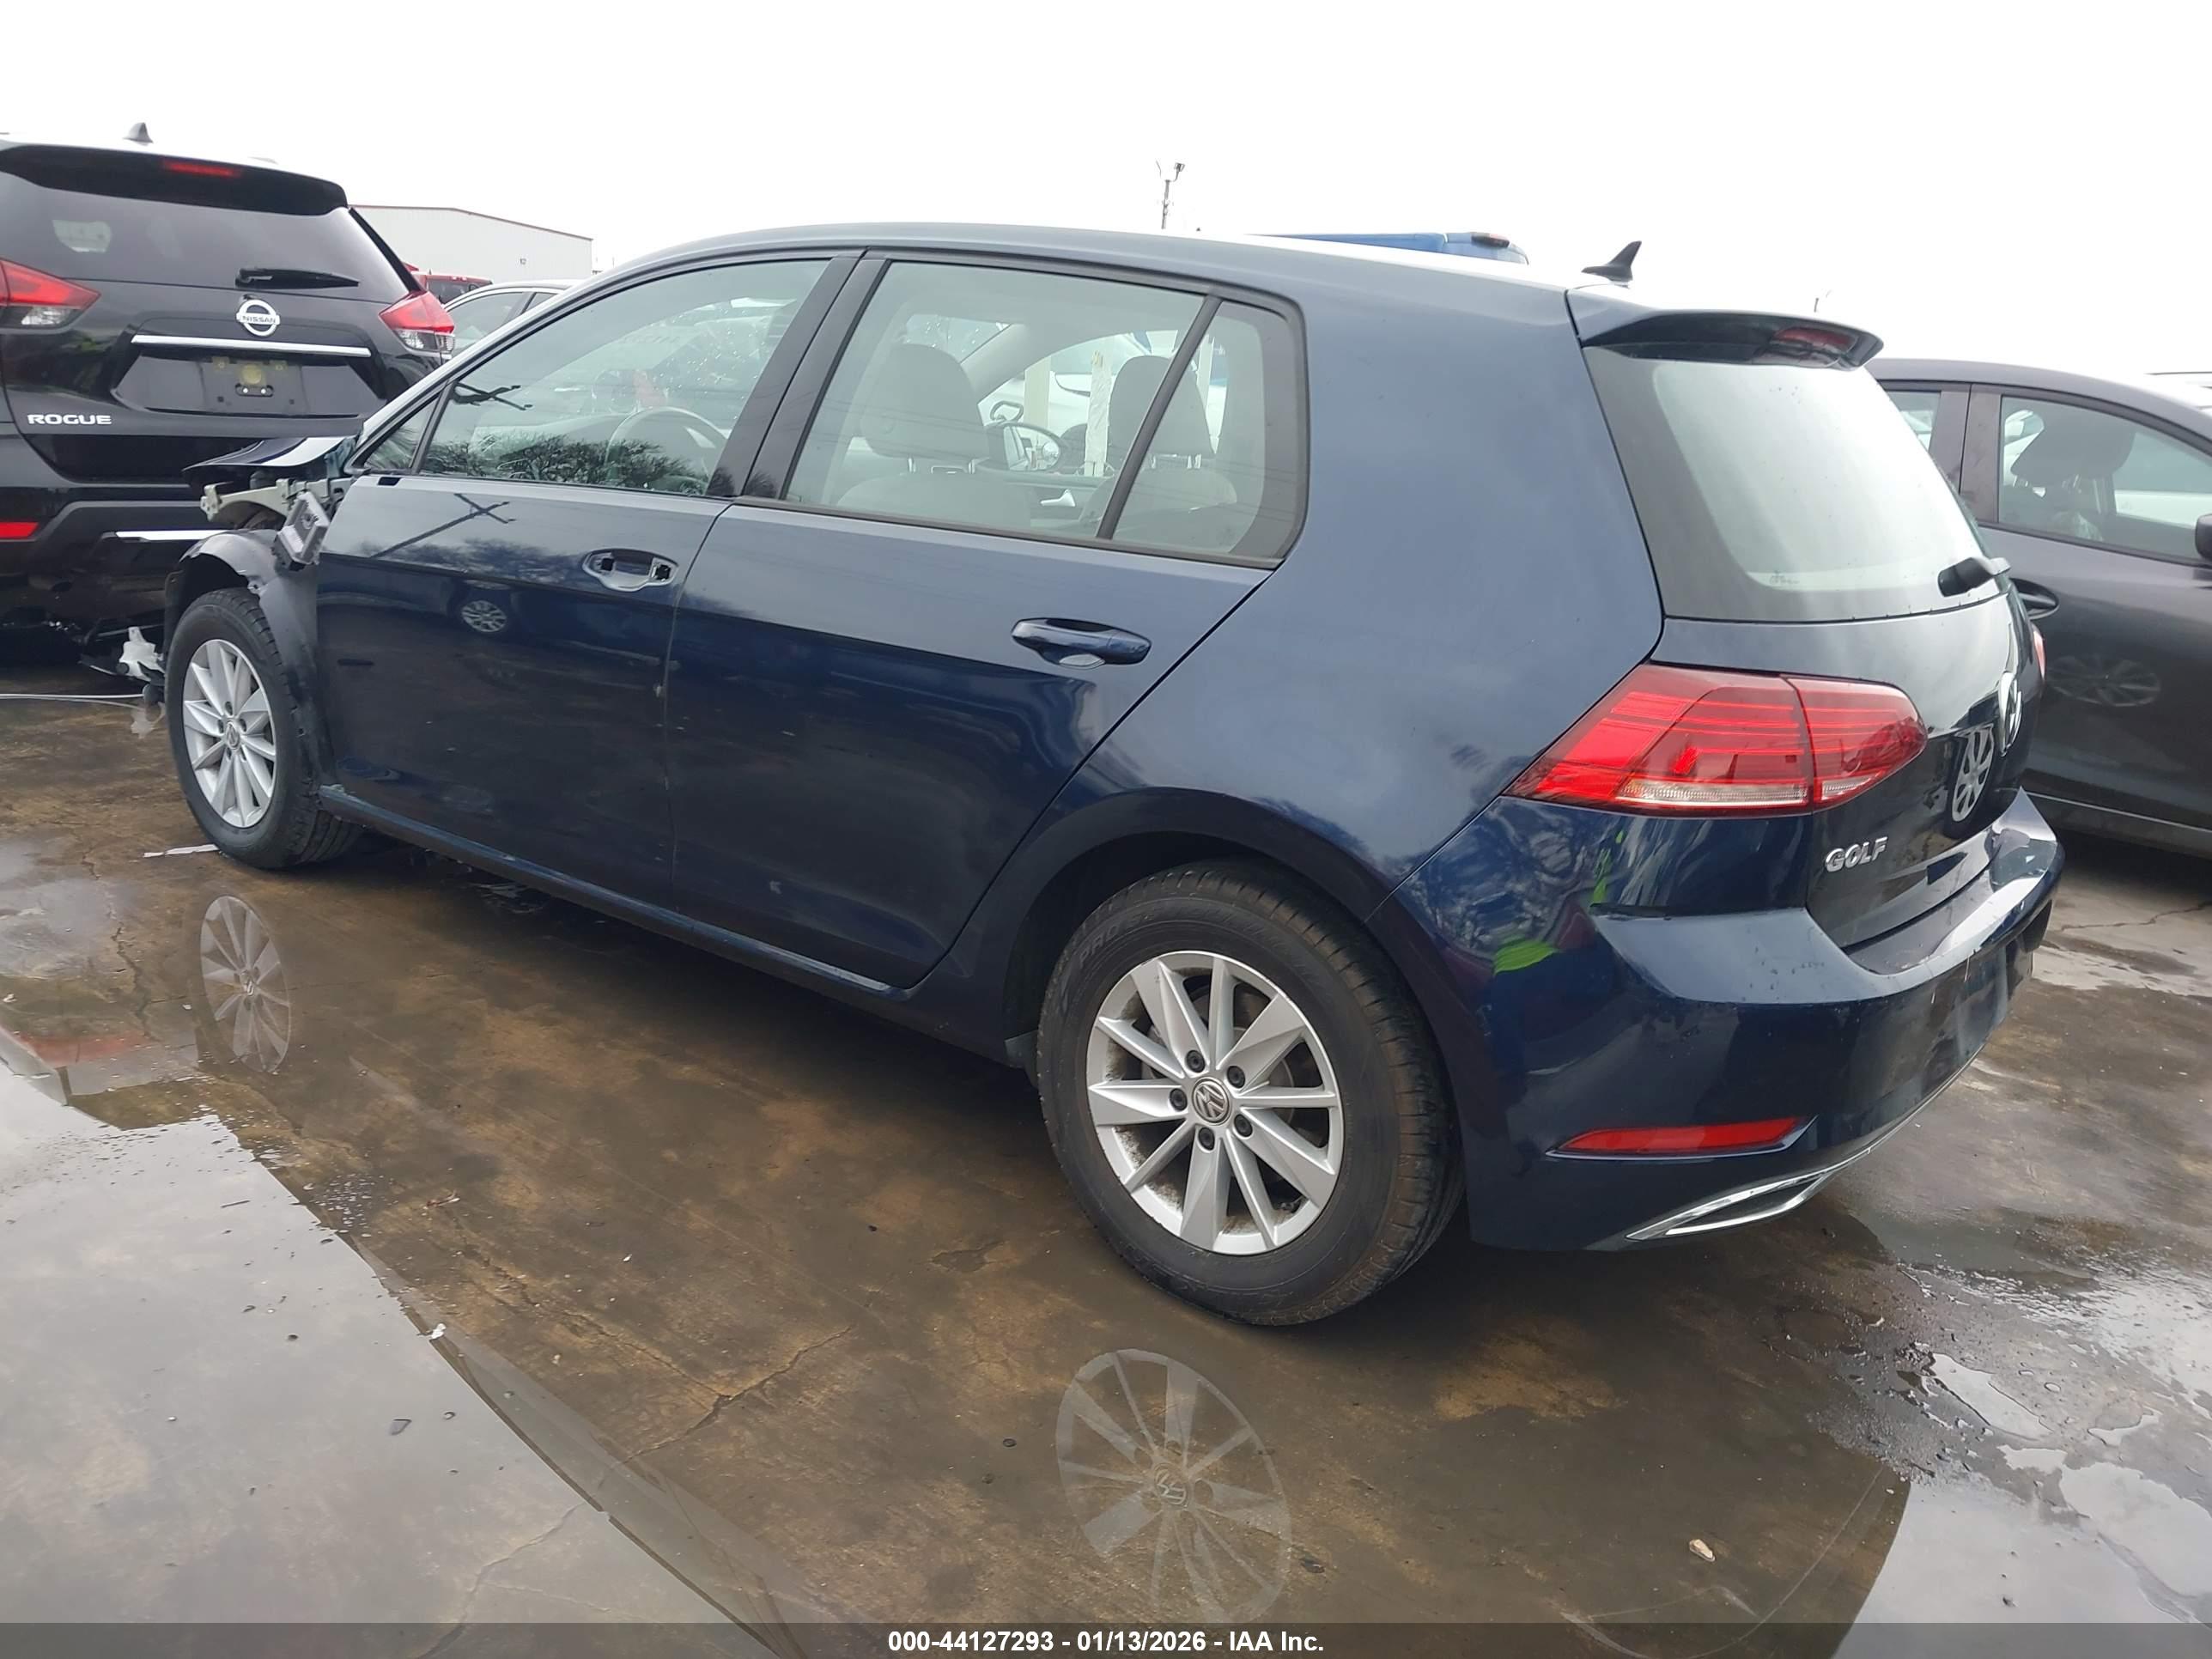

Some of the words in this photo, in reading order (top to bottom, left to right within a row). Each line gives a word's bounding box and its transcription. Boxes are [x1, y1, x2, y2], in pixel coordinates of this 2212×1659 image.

[242, 315, 276, 324] NISSAN
[27, 414, 112, 425] ROGUE
[1826, 836, 1888, 872] GOLF
